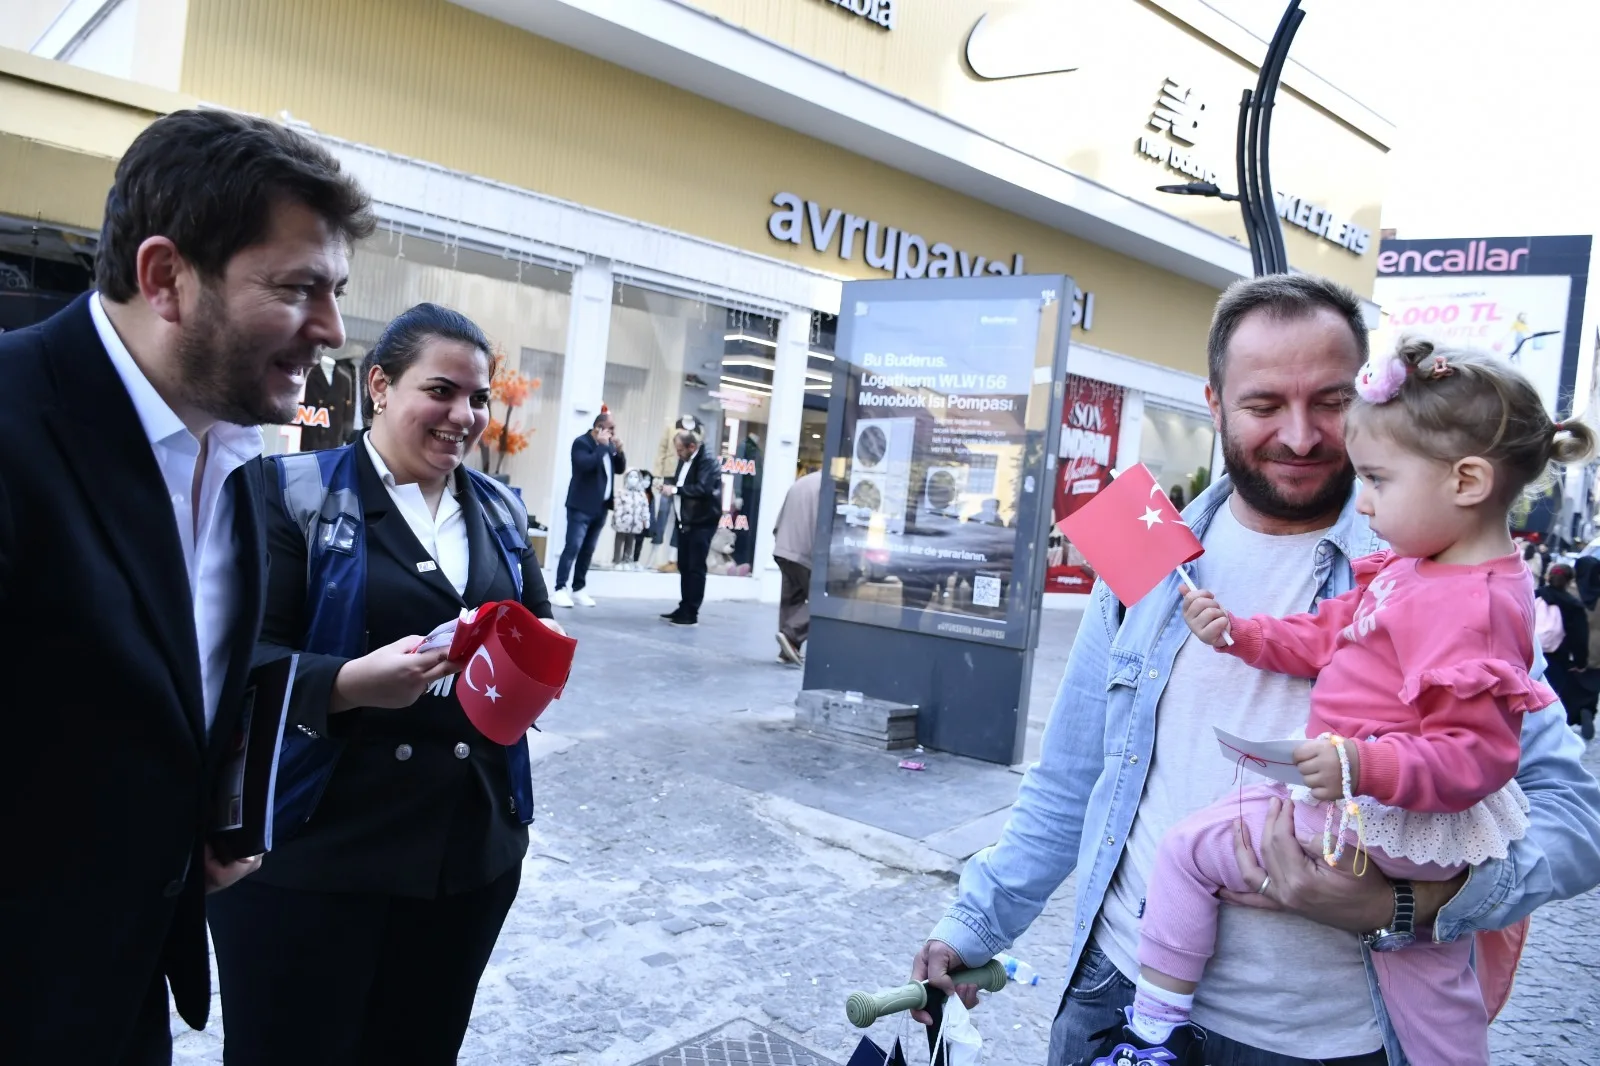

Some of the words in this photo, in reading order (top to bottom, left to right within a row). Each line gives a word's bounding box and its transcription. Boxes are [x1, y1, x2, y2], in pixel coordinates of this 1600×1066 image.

[863, 352, 881, 367] Bu
[884, 353, 947, 368] Buderus.
[861, 373, 936, 390] Logatherm
[858, 391, 926, 408] Monoblok
